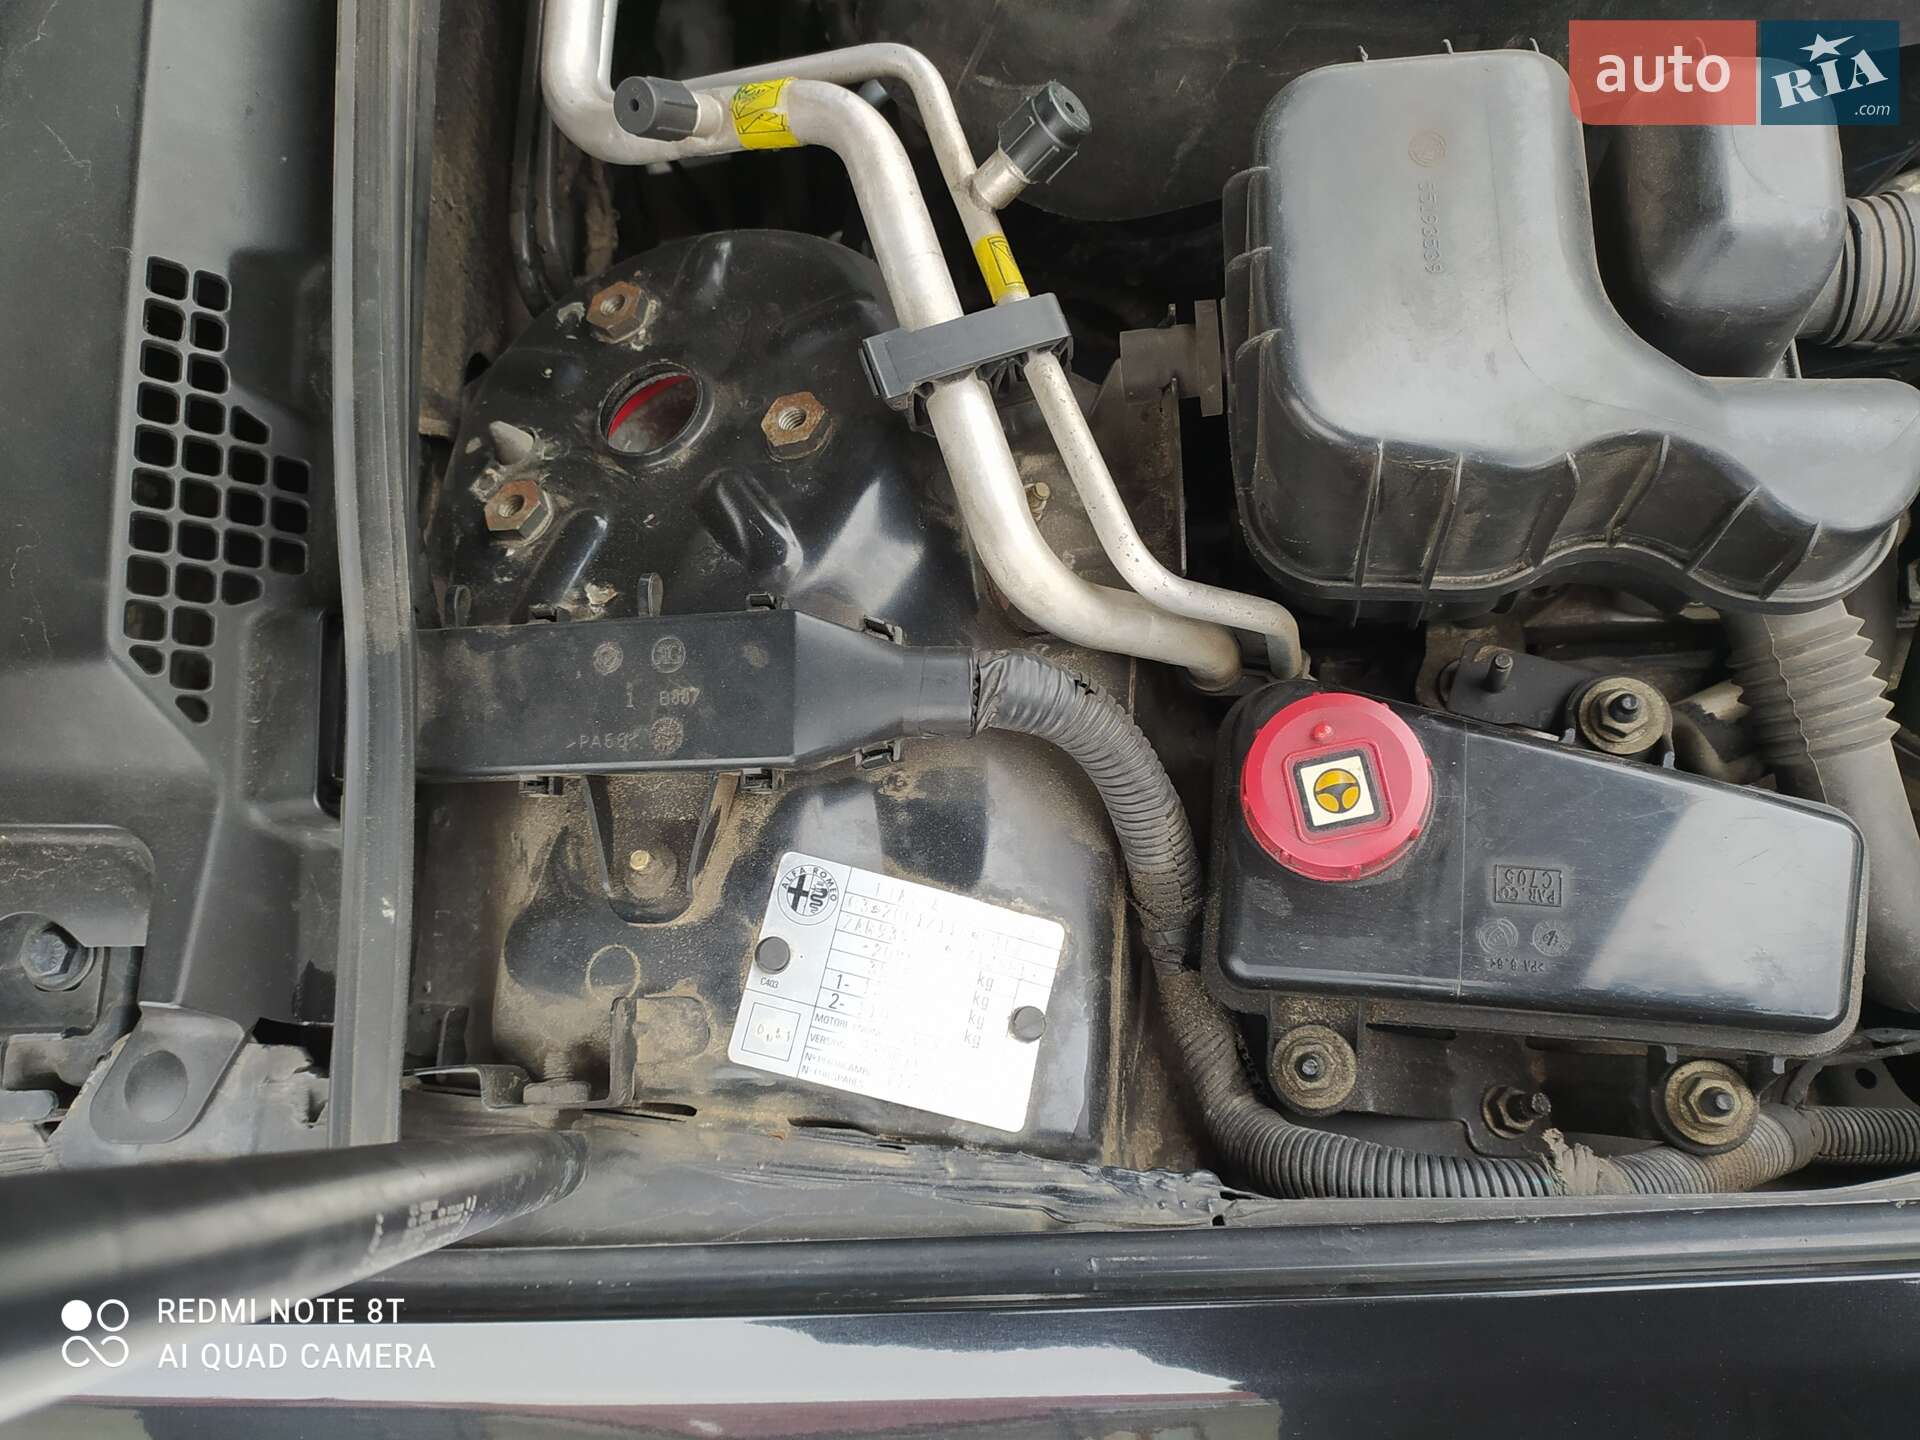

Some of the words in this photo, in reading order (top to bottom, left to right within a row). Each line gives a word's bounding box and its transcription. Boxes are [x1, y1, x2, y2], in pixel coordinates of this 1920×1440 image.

[781, 867, 806, 890] ALFA
[813, 867, 837, 902] ROMEO
[977, 974, 994, 991] kg
[973, 994, 990, 1010] kg
[968, 1013, 985, 1031] kg
[964, 1031, 980, 1049] kg
